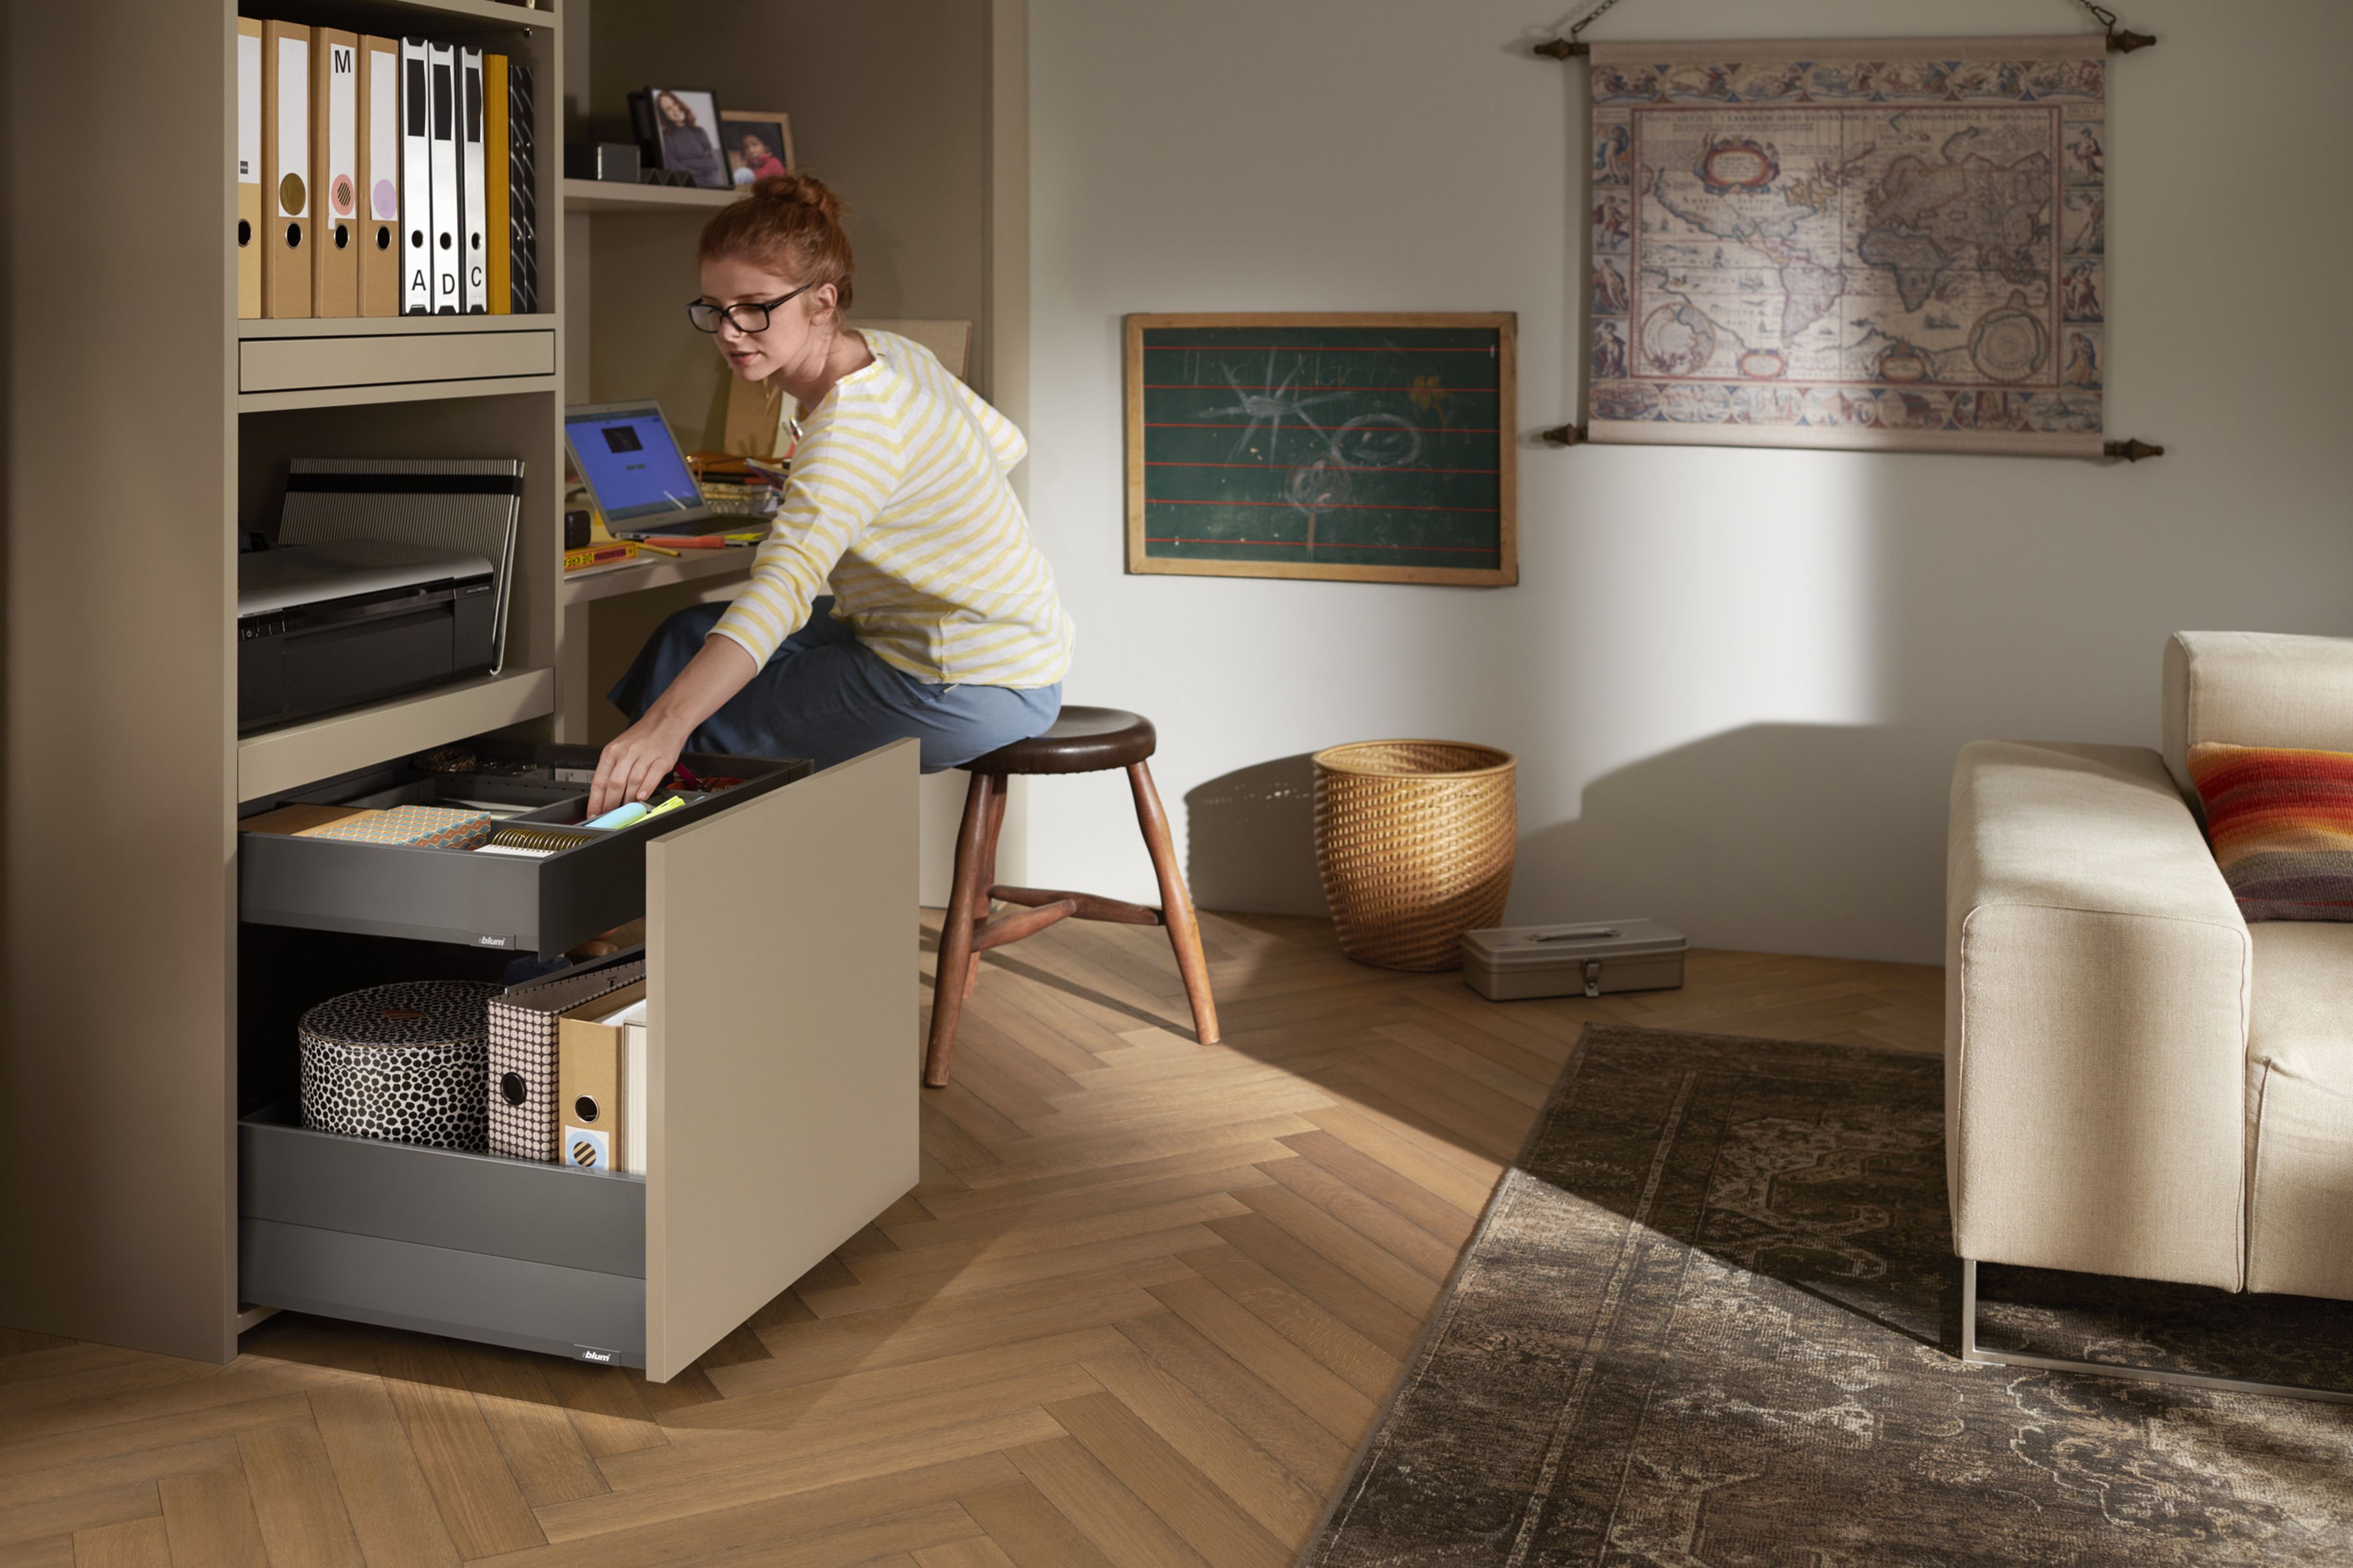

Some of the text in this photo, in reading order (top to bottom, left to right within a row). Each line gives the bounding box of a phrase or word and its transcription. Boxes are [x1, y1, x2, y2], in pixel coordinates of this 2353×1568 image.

[335, 50, 350, 74] M
[412, 269, 426, 290] A
[442, 273, 455, 295] D
[471, 266, 482, 287] C
[481, 936, 504, 946] blum
[585, 1350, 610, 1362] blum
